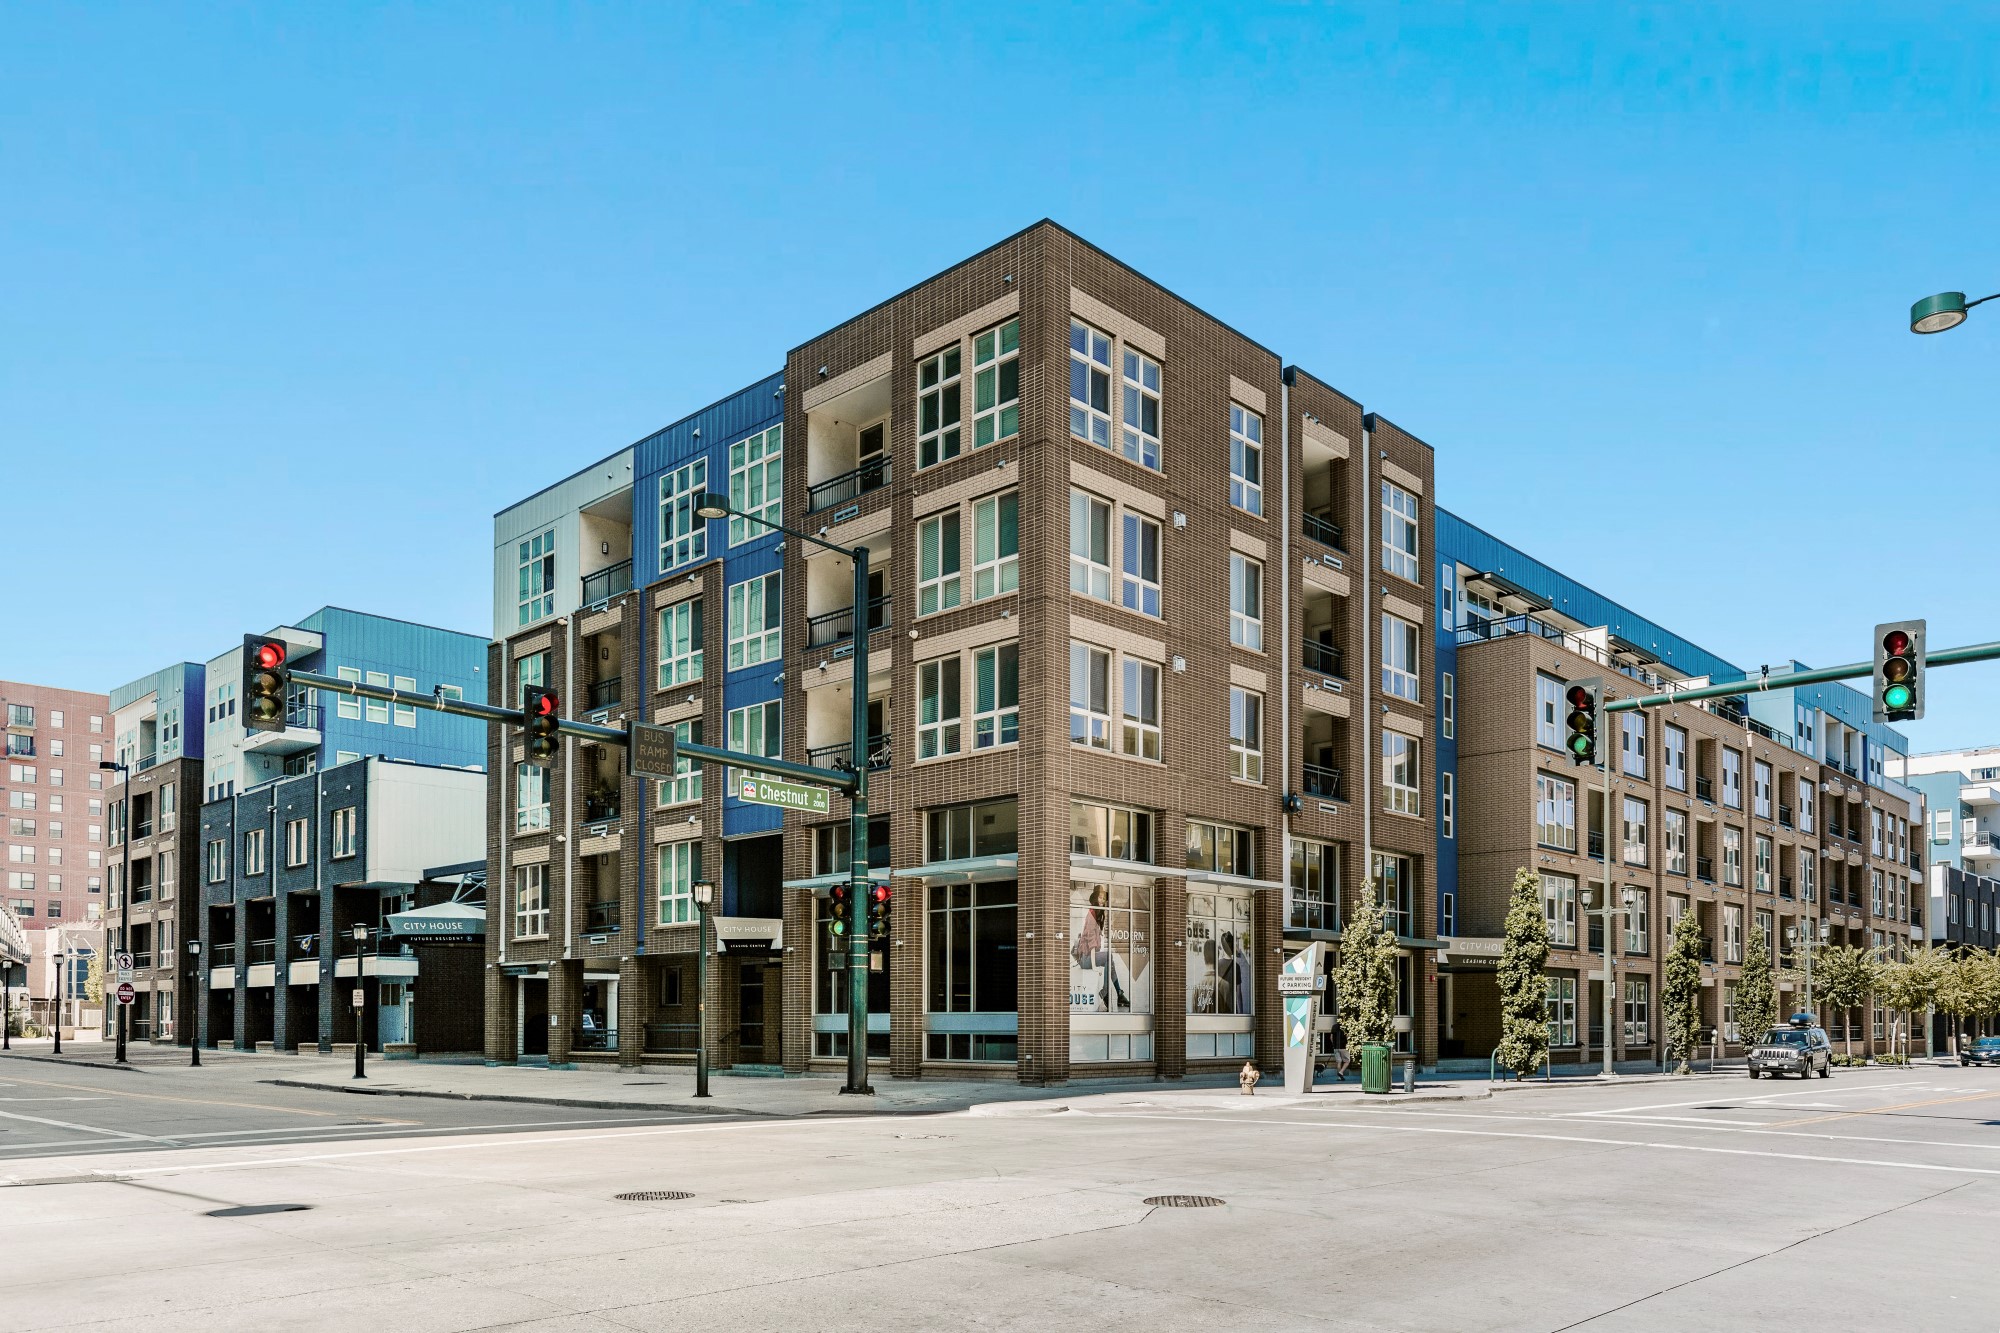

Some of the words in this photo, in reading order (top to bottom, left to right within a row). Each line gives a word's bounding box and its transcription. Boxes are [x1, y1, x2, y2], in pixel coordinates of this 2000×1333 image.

[644, 730, 665, 744] BUS
[639, 744, 669, 759] RAMP
[635, 759, 672, 774] CLOSED
[760, 783, 809, 806] Chestnut
[813, 800, 826, 809] 2000
[403, 922, 427, 930] CITY
[429, 922, 464, 930] HOUSE
[1187, 927, 1210, 939] OUSE
[1460, 941, 1482, 950] CITY
[1484, 943, 1504, 952] HOU
[1069, 993, 1095, 1005] OUSE
